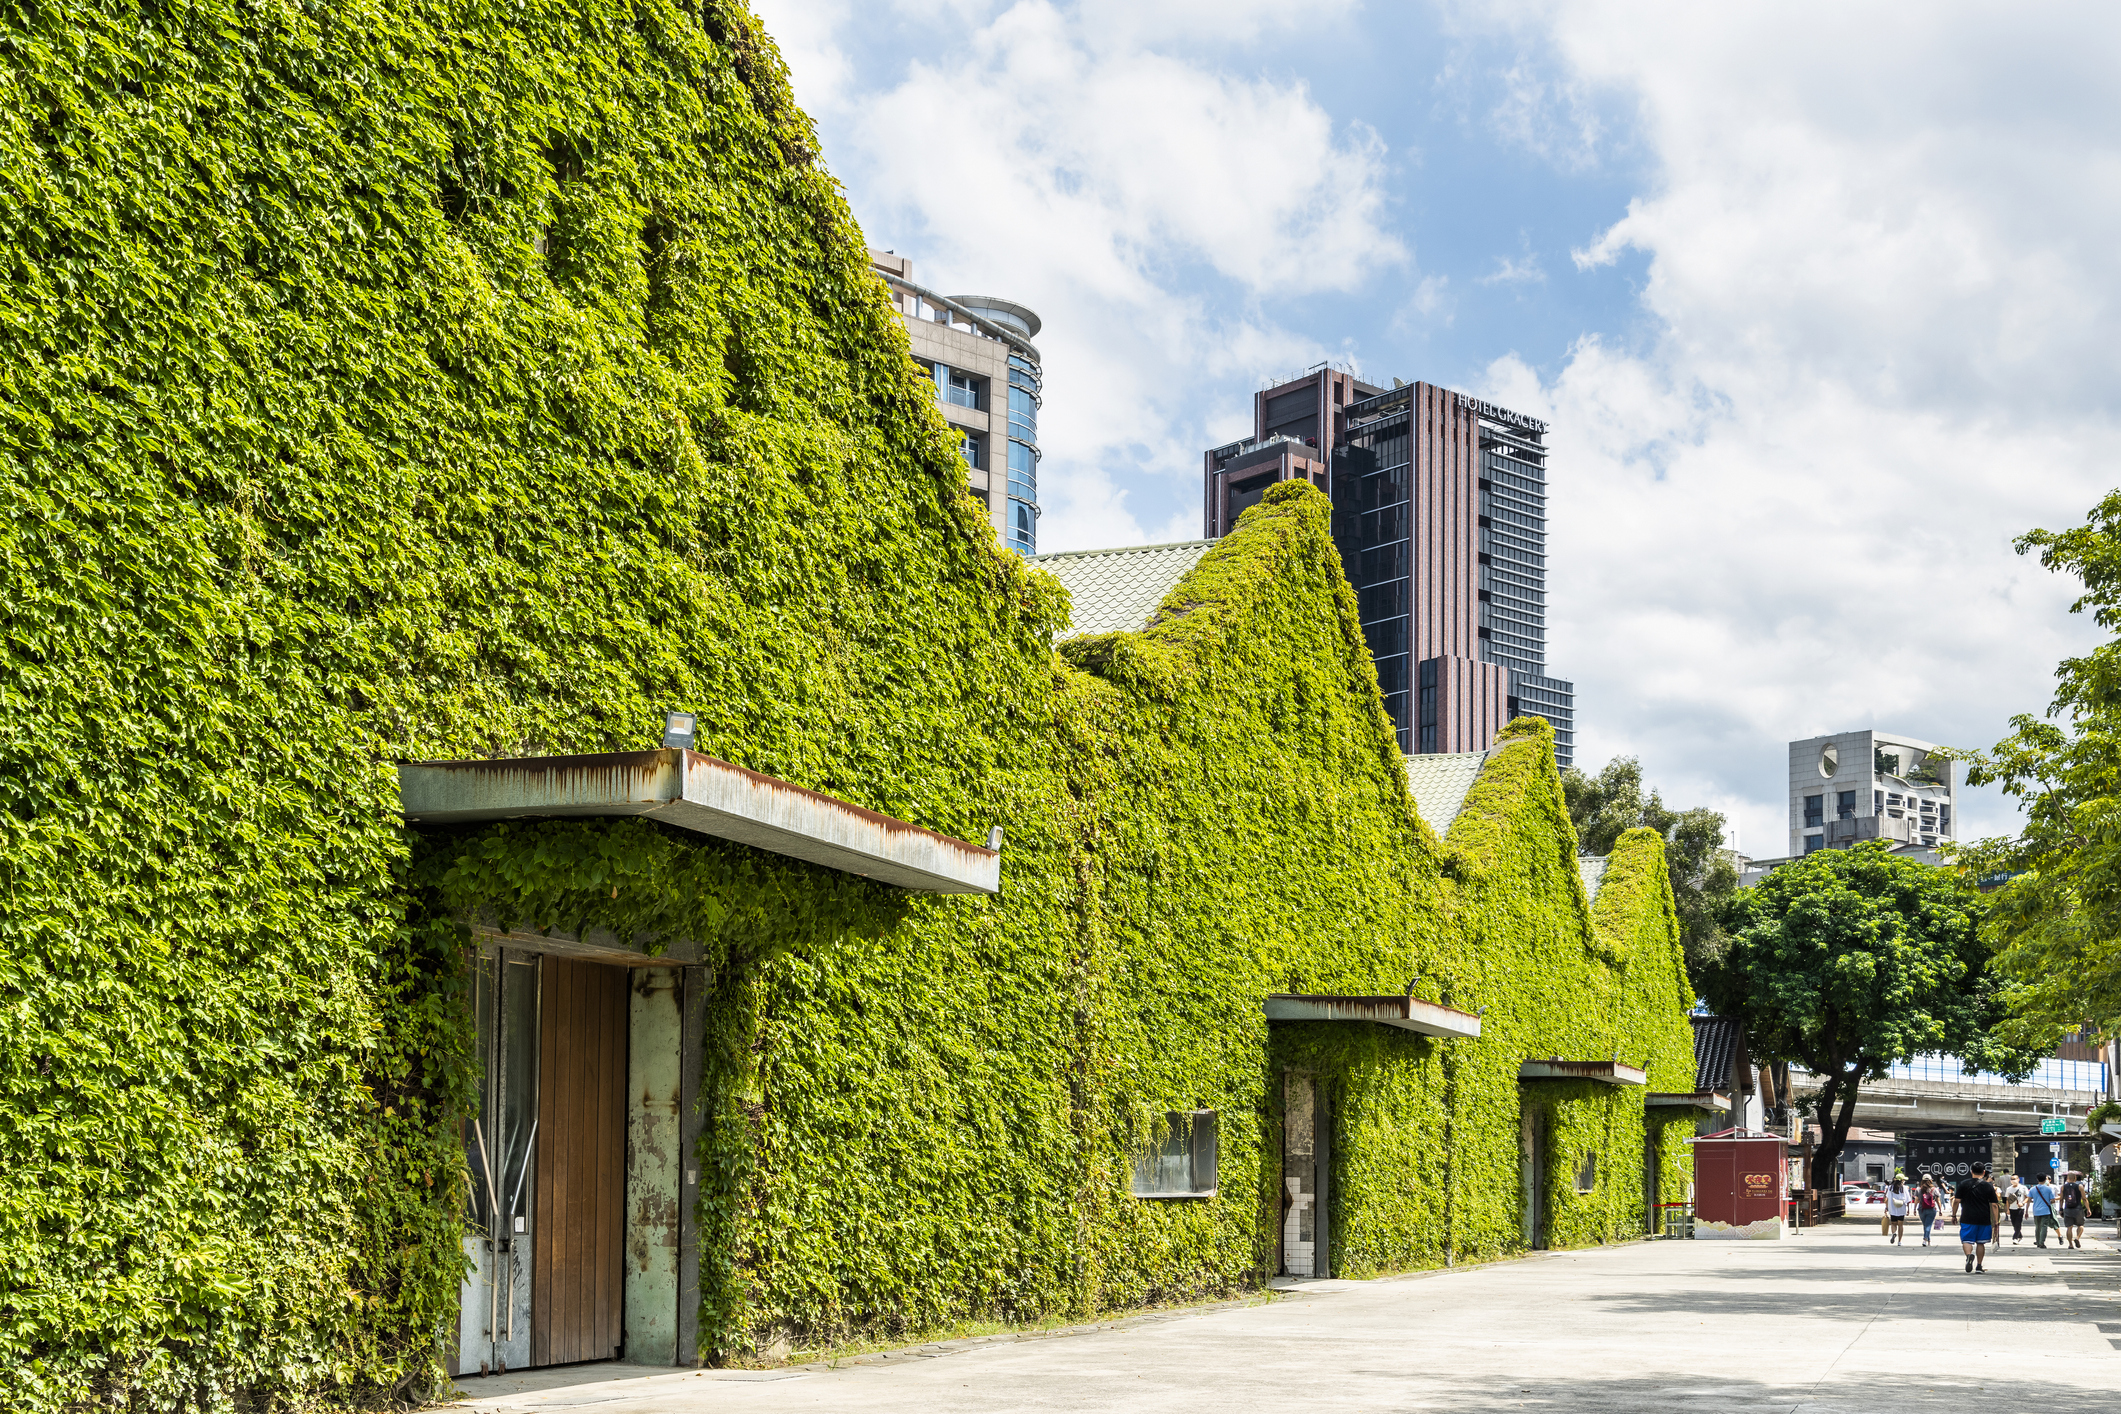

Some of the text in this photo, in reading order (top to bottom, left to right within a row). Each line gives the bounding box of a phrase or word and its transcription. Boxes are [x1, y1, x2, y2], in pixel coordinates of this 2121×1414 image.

[1458, 393, 1549, 433] HOTEL GRACERY
[1928, 1146, 1992, 1154] 歡迎光臨八德
